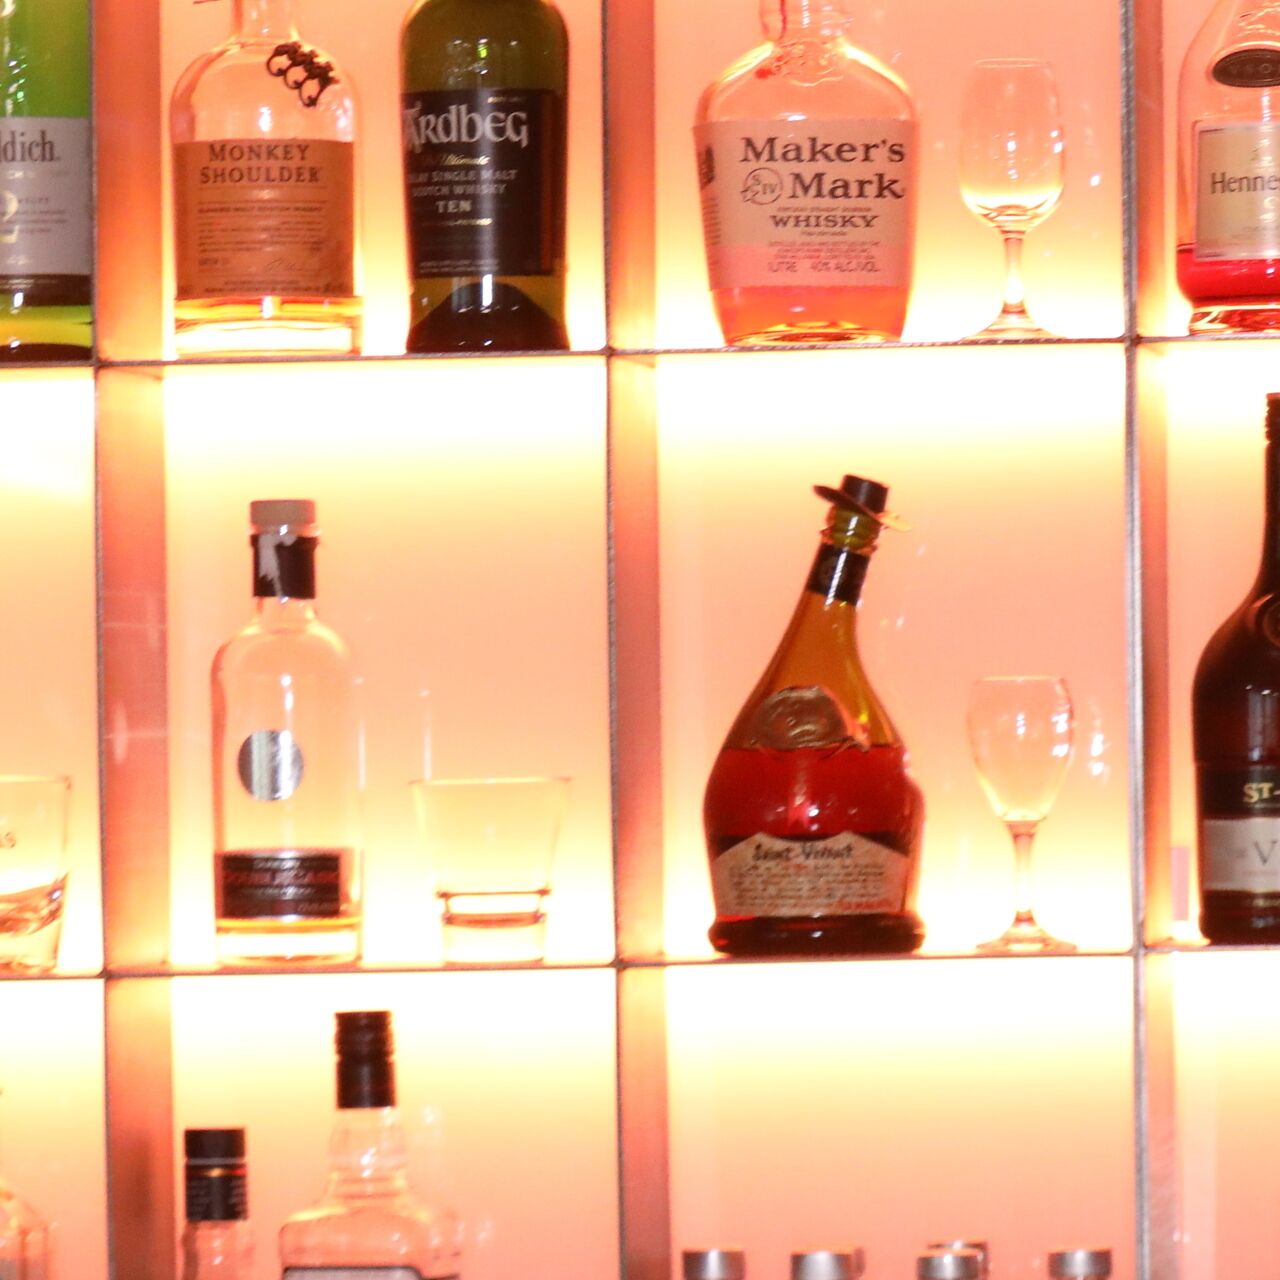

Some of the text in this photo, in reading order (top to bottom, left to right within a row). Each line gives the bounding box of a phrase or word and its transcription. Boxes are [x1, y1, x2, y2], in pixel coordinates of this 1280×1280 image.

[0, 130, 55, 162] dich
[209, 144, 310, 162] MONKEY
[740, 137, 905, 163] Maker's
[200, 167, 320, 184] SHOULDER
[788, 172, 905, 199] Mark
[435, 200, 472, 213] TEN
[769, 215, 880, 228] WHISKY
